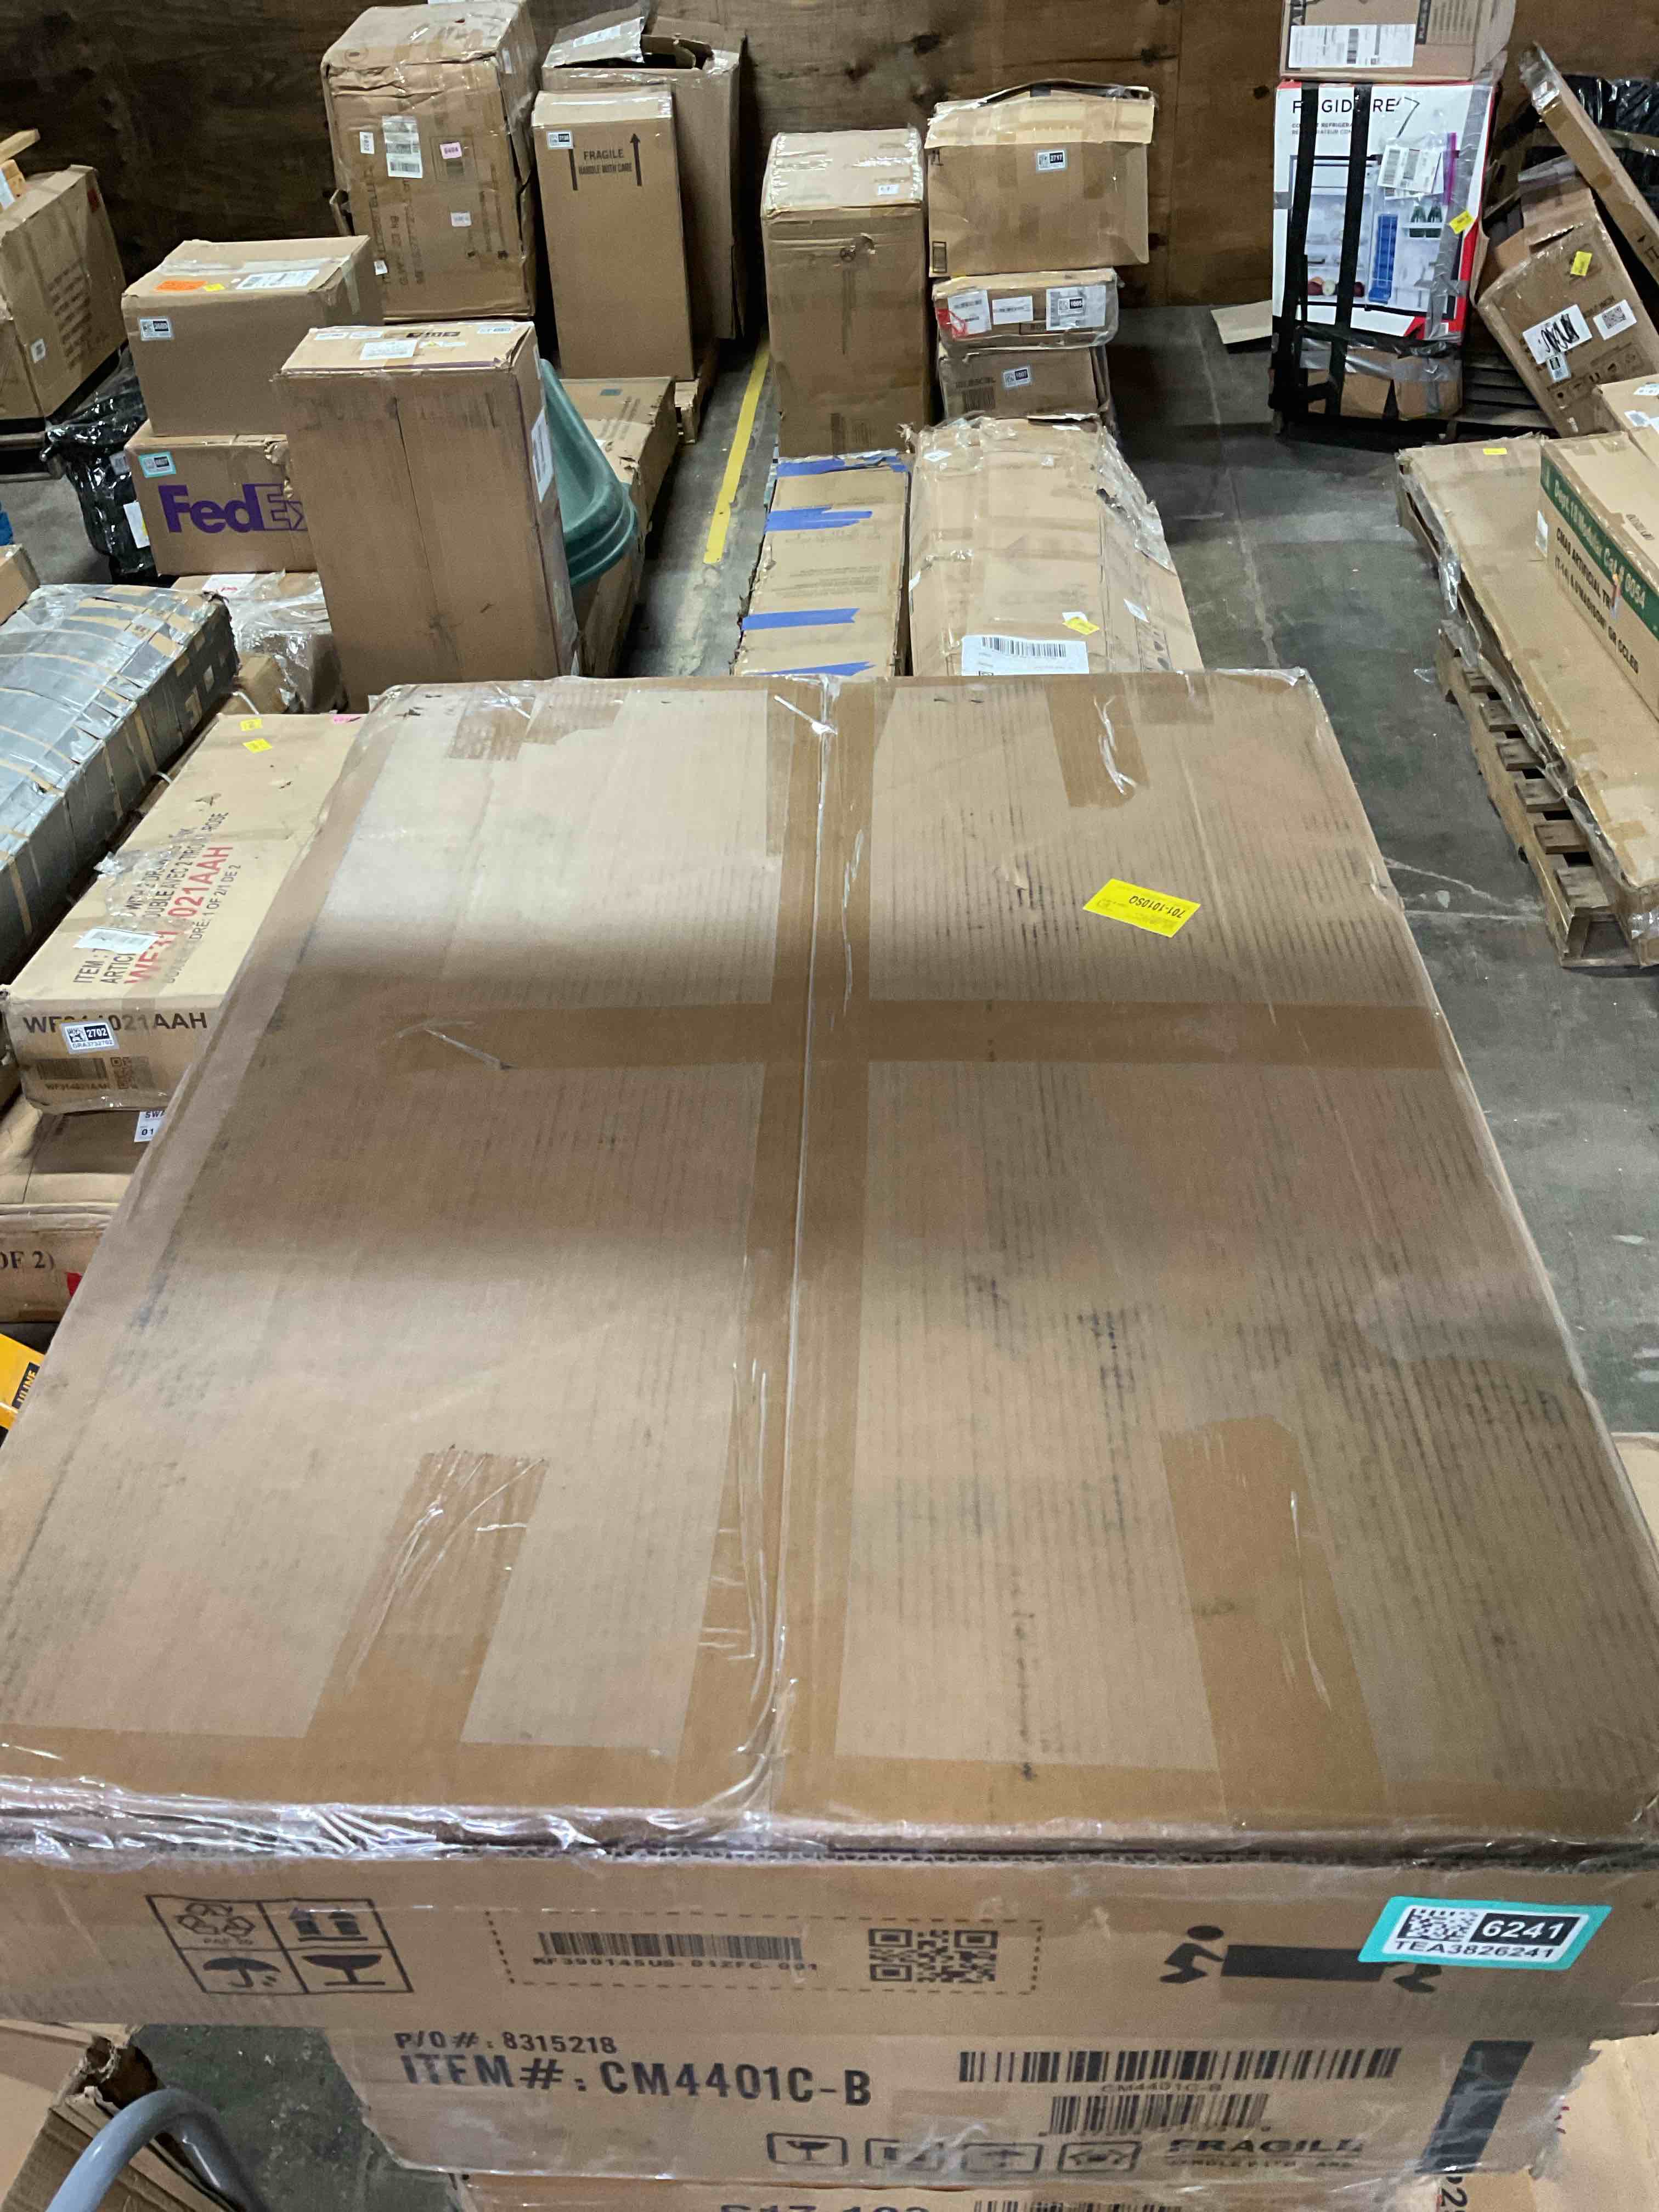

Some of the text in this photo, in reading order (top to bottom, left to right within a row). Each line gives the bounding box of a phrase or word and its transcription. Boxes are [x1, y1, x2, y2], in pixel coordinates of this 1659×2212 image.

[1293, 99, 1396, 114] FGIDRE
[584, 149, 624, 160] FRAGILE
[222, 870, 238, 883] DE
[24, 1012, 207, 1033] WF021AAH
[87, 1028, 108, 1038] 2702
[1483, 1920, 1565, 1939] 6241
[1395, 1940, 1554, 1959] TEA3826241
[502, 2031, 618, 2055] 8315218
[600, 2060, 872, 2107] CM4401C-B
